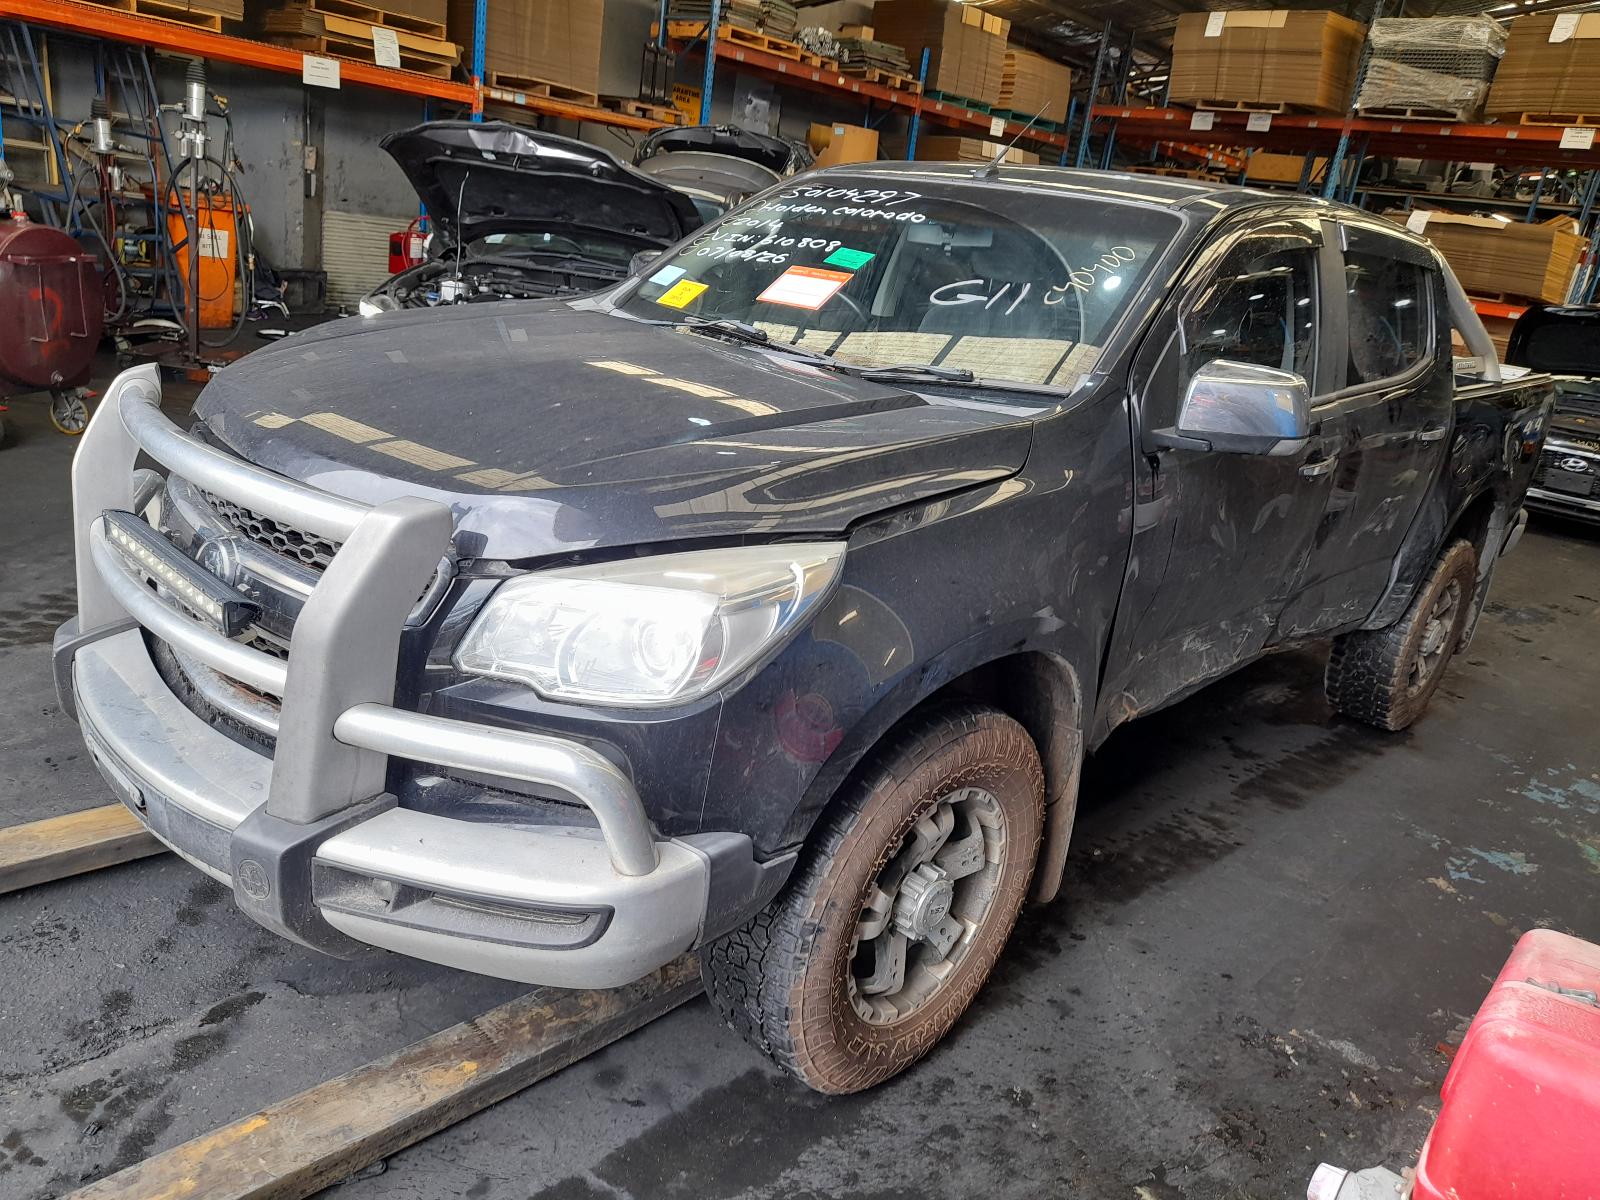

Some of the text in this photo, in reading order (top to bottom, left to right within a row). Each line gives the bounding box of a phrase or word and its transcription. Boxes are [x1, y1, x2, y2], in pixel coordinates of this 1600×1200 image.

[779, 186, 923, 206] 50104297
[757, 202, 827, 215] Holden
[732, 217, 784, 231] 2014
